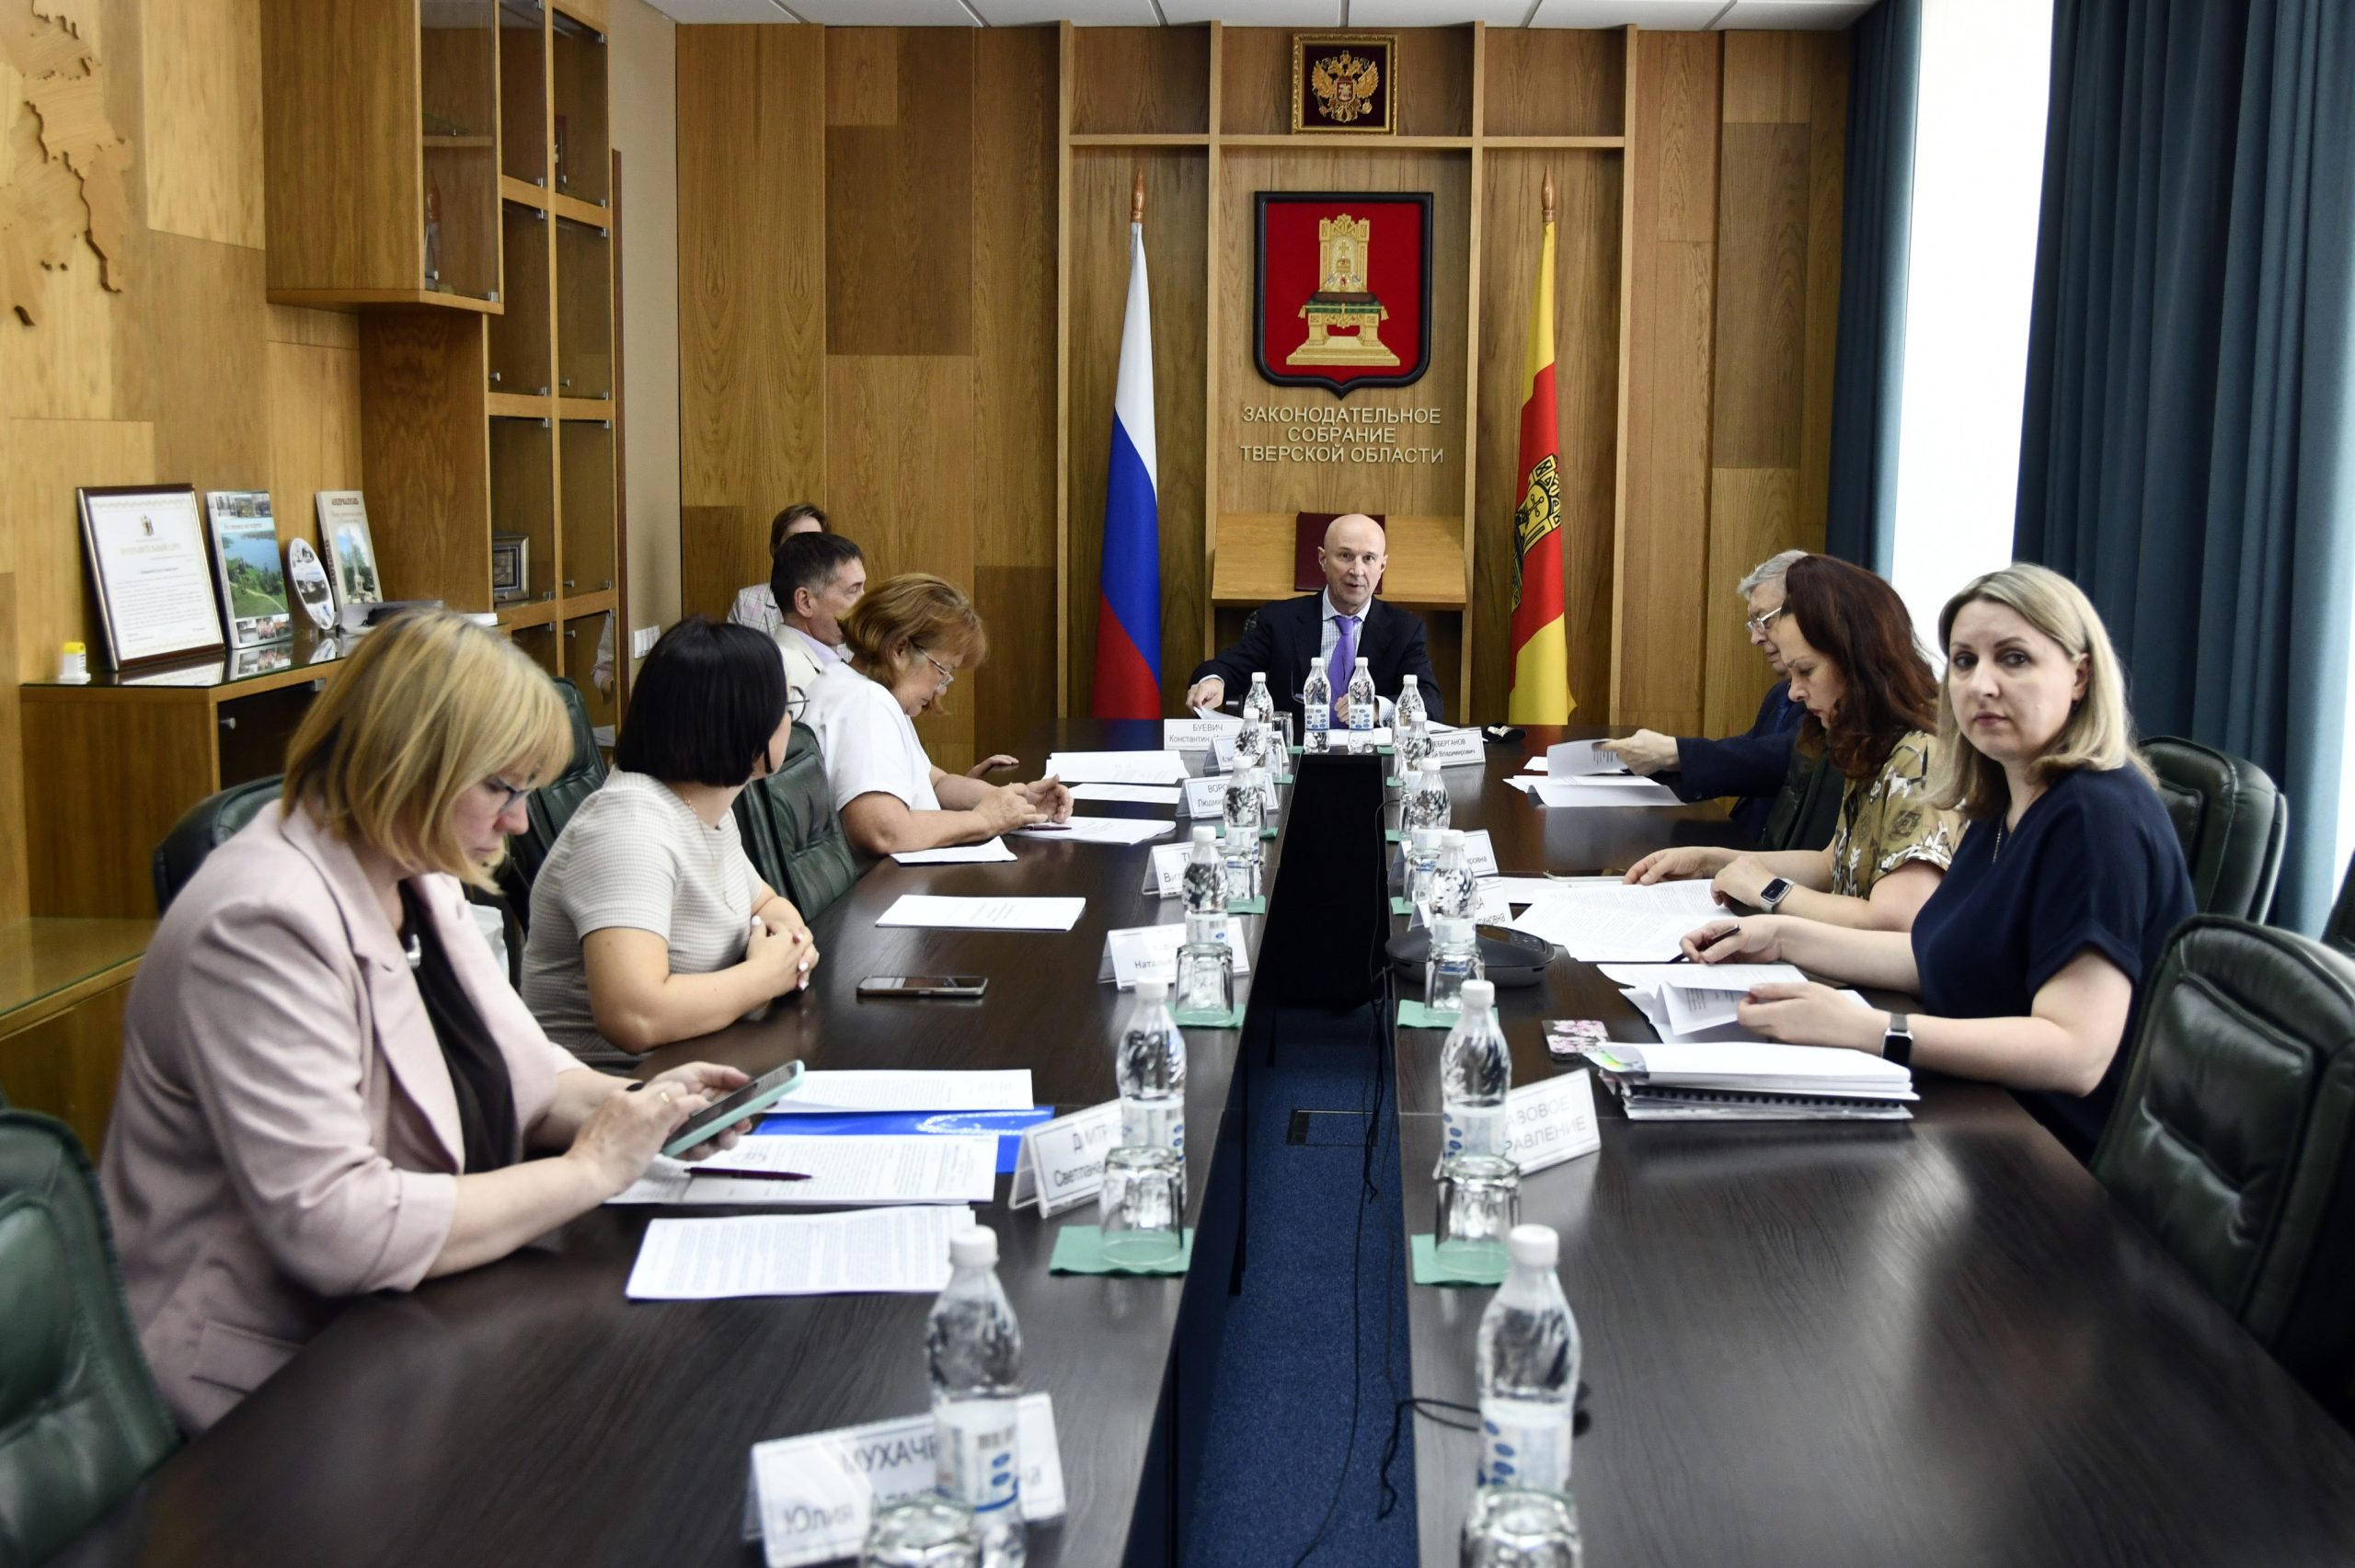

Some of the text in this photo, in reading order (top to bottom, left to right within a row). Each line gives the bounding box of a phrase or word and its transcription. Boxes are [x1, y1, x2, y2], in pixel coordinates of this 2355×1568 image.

[1242, 406, 1442, 426] ЗАКОНОДАТЕЛЬНОЕ
[1288, 427, 1396, 442] СОБРАНИЕ
[1241, 444, 1443, 464] ТВЕРСКОЙ ОБЛАСТИ
[1192, 724, 1223, 732] БУЕВИЧ
[1169, 734, 1210, 743] Константин
[1207, 783, 1229, 793] ВОРО
[1198, 798, 1223, 808] Людми
